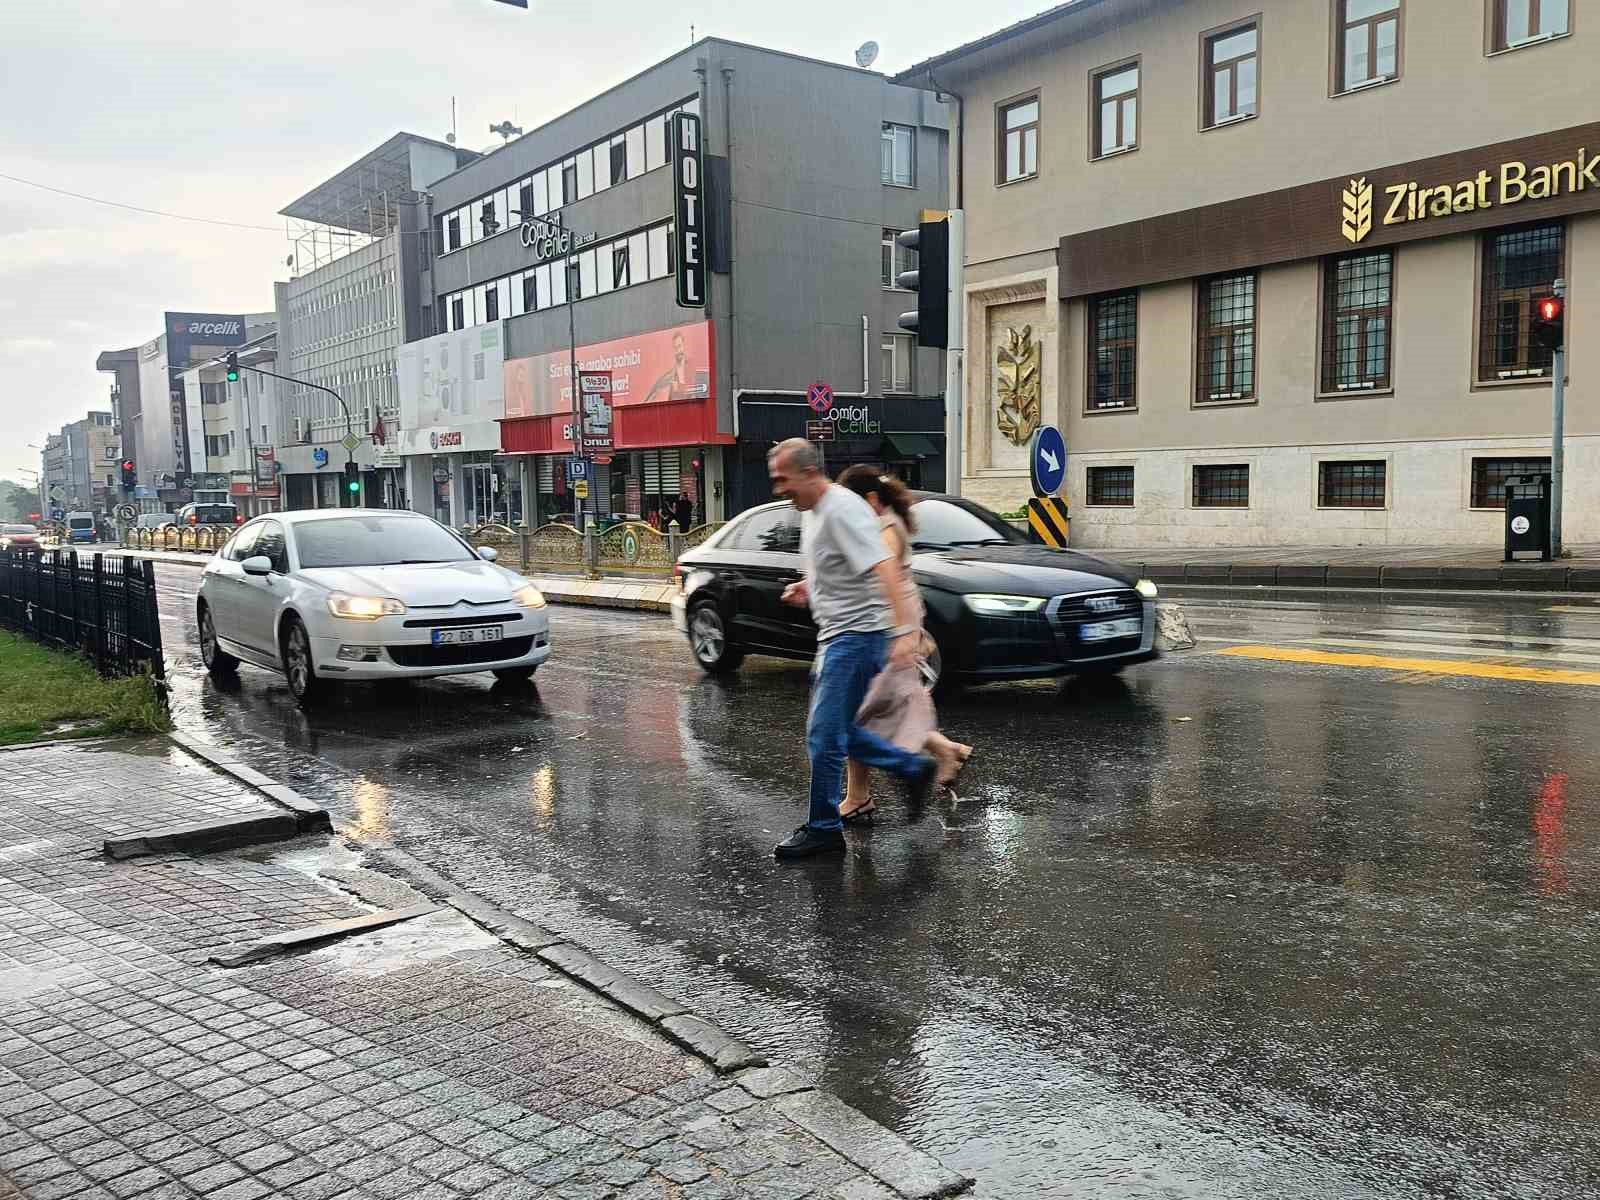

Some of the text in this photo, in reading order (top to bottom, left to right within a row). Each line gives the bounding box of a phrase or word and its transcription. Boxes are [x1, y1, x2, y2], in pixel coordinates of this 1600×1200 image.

[1383, 147, 1600, 226] Ziraat Bank
[681, 118, 699, 301] HOTEL
[520, 211, 562, 247] Comfort
[188, 321, 240, 337] arçelik
[585, 377, 608, 386] %30
[838, 420, 880, 433] Center
